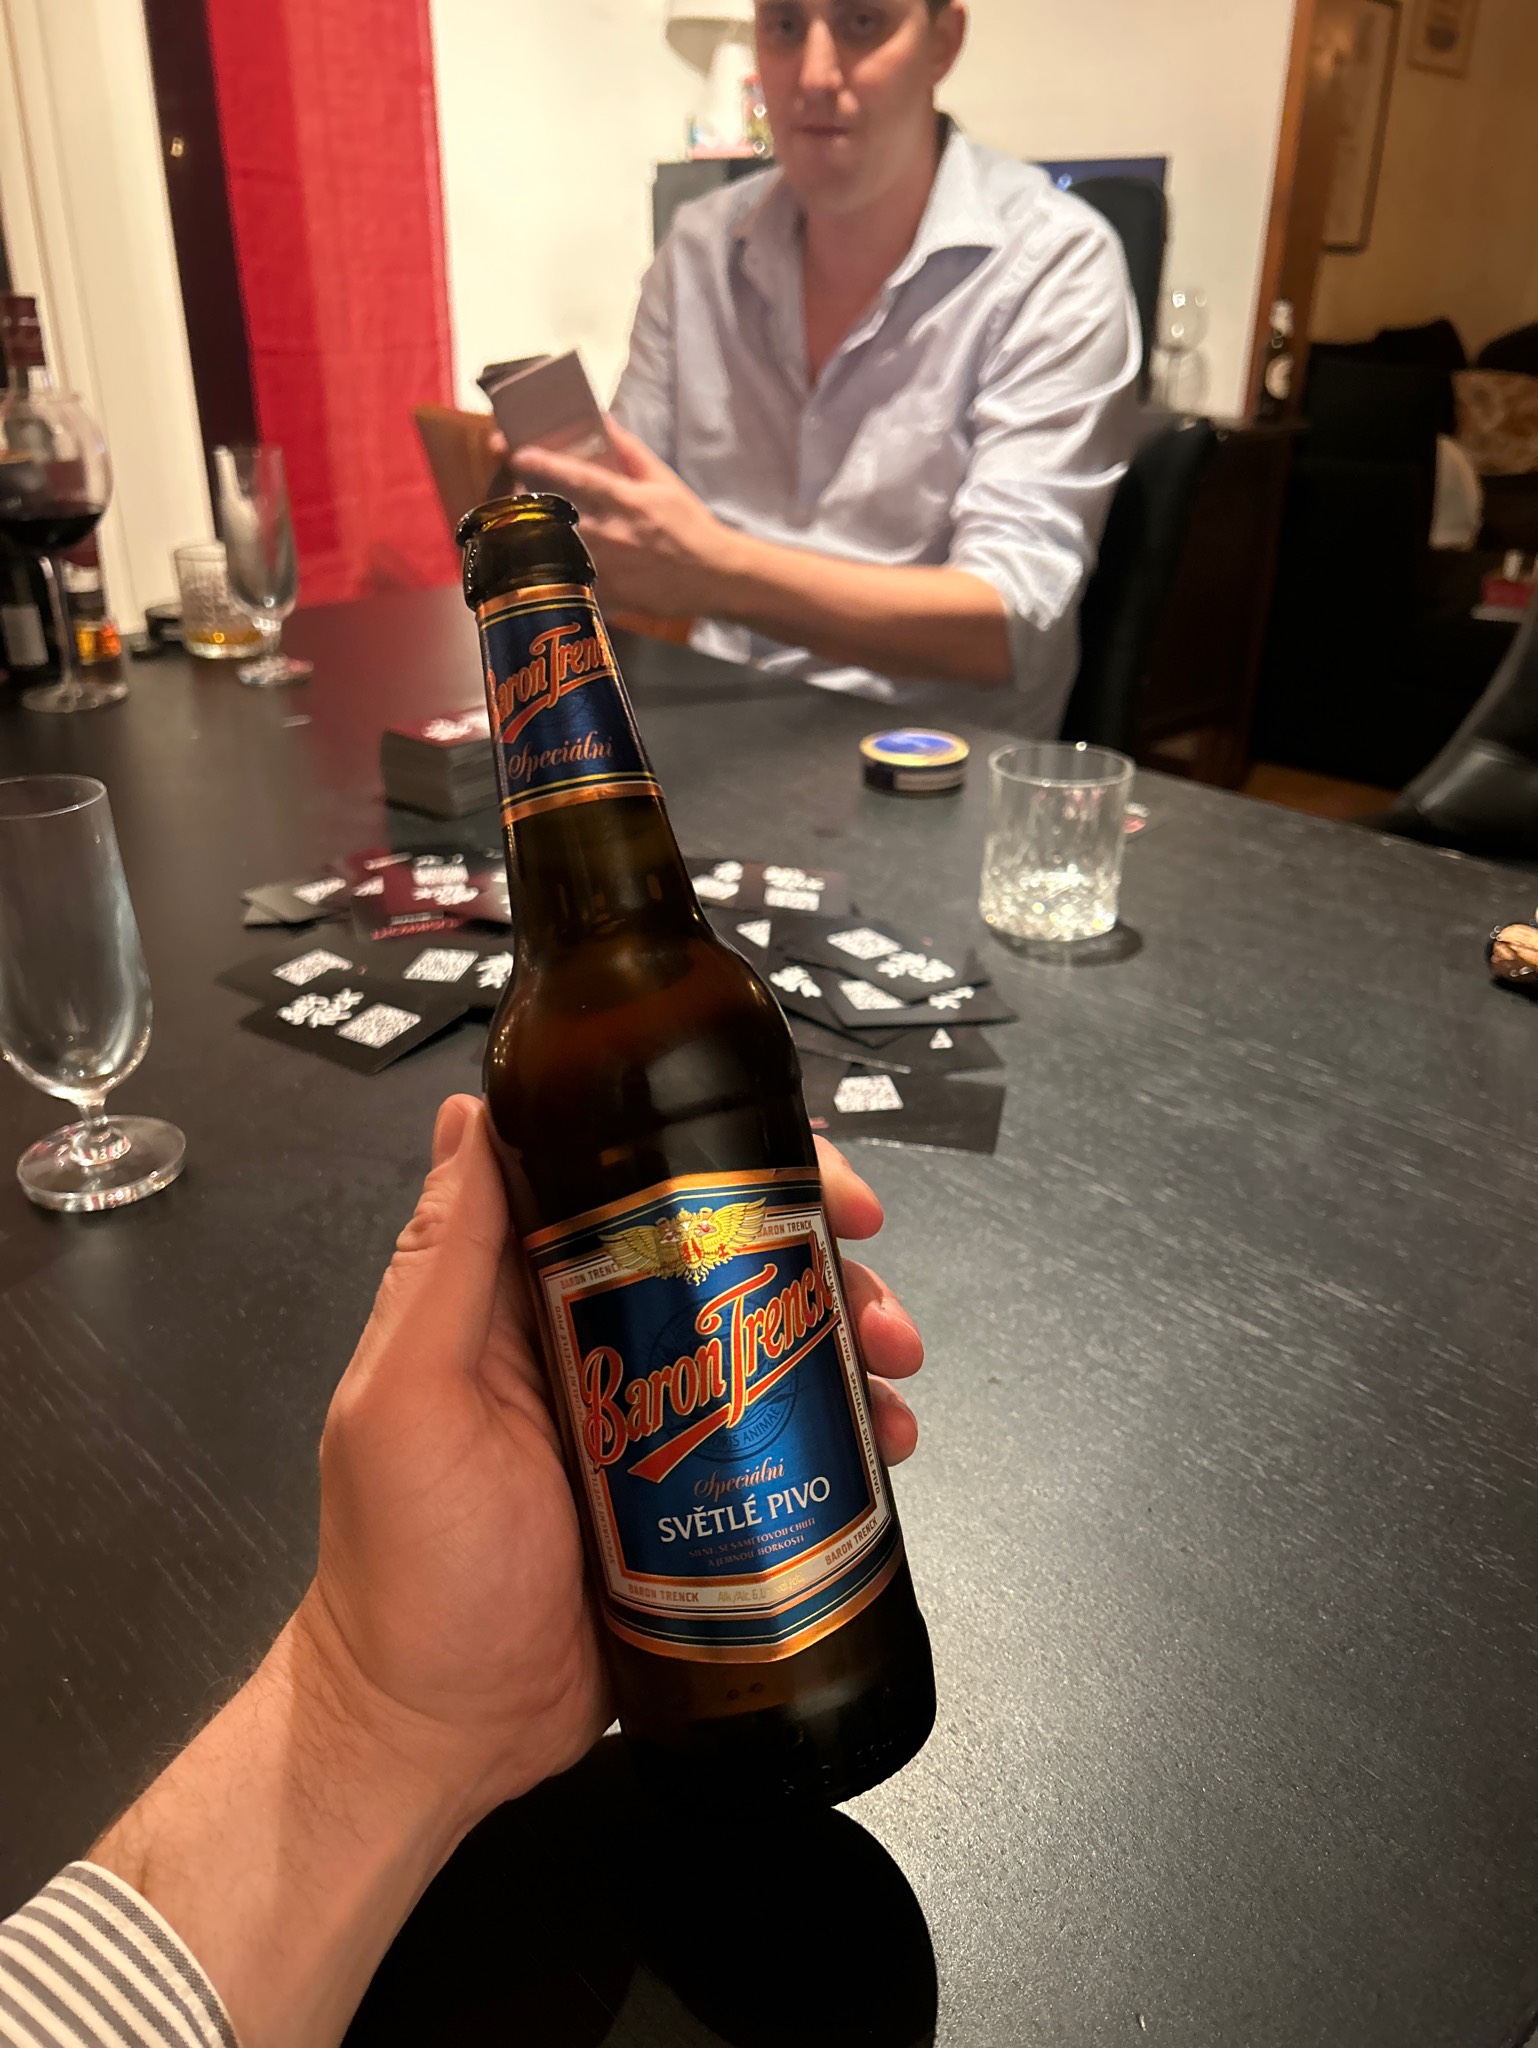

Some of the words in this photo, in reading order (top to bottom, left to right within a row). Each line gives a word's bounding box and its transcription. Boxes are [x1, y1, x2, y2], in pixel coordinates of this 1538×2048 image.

[787, 1219, 812, 1233] TRENCK
[580, 1338, 727, 1469] Baron
[696, 1231, 833, 1428] Trenck
[743, 1406, 780, 1445] ANIMAE
[871, 1470, 881, 1494] PIVO
[658, 1493, 762, 1543] SVĚTLÉ
[767, 1476, 830, 1519] PIVO
[825, 1540, 853, 1566] BARON
[853, 1516, 878, 1543] TRENCK
[628, 1583, 656, 1599] BARON
[660, 1590, 699, 1603] TRENCK
